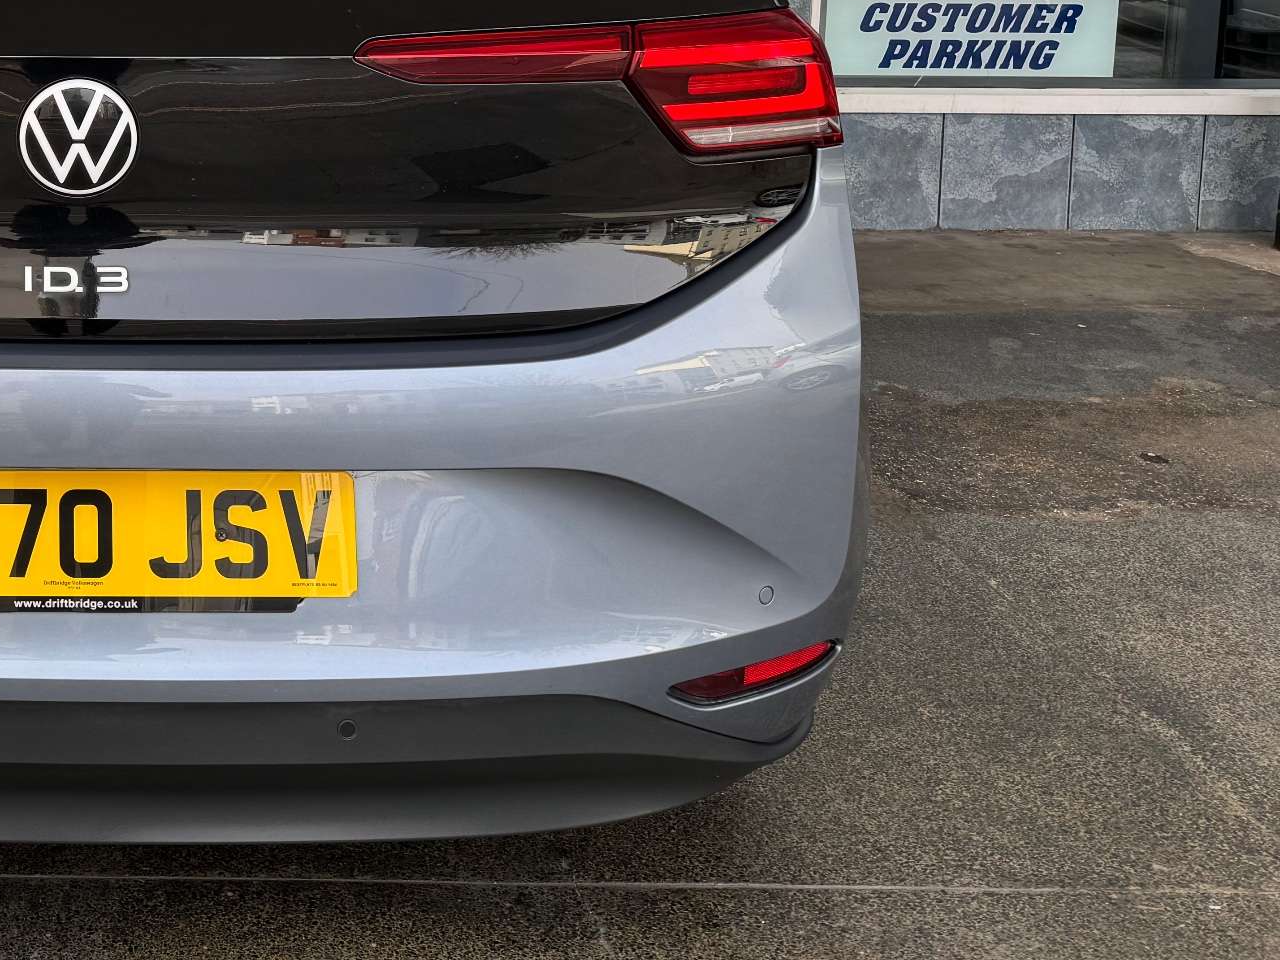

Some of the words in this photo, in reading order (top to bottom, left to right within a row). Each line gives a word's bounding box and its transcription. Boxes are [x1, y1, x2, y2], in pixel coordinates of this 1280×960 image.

[859, 2, 1084, 34] CUSTOMER
[878, 39, 1060, 71] PARKING
[148, 489, 333, 580] JSV
[13, 598, 138, 610] www.driftbridge.co.uk
